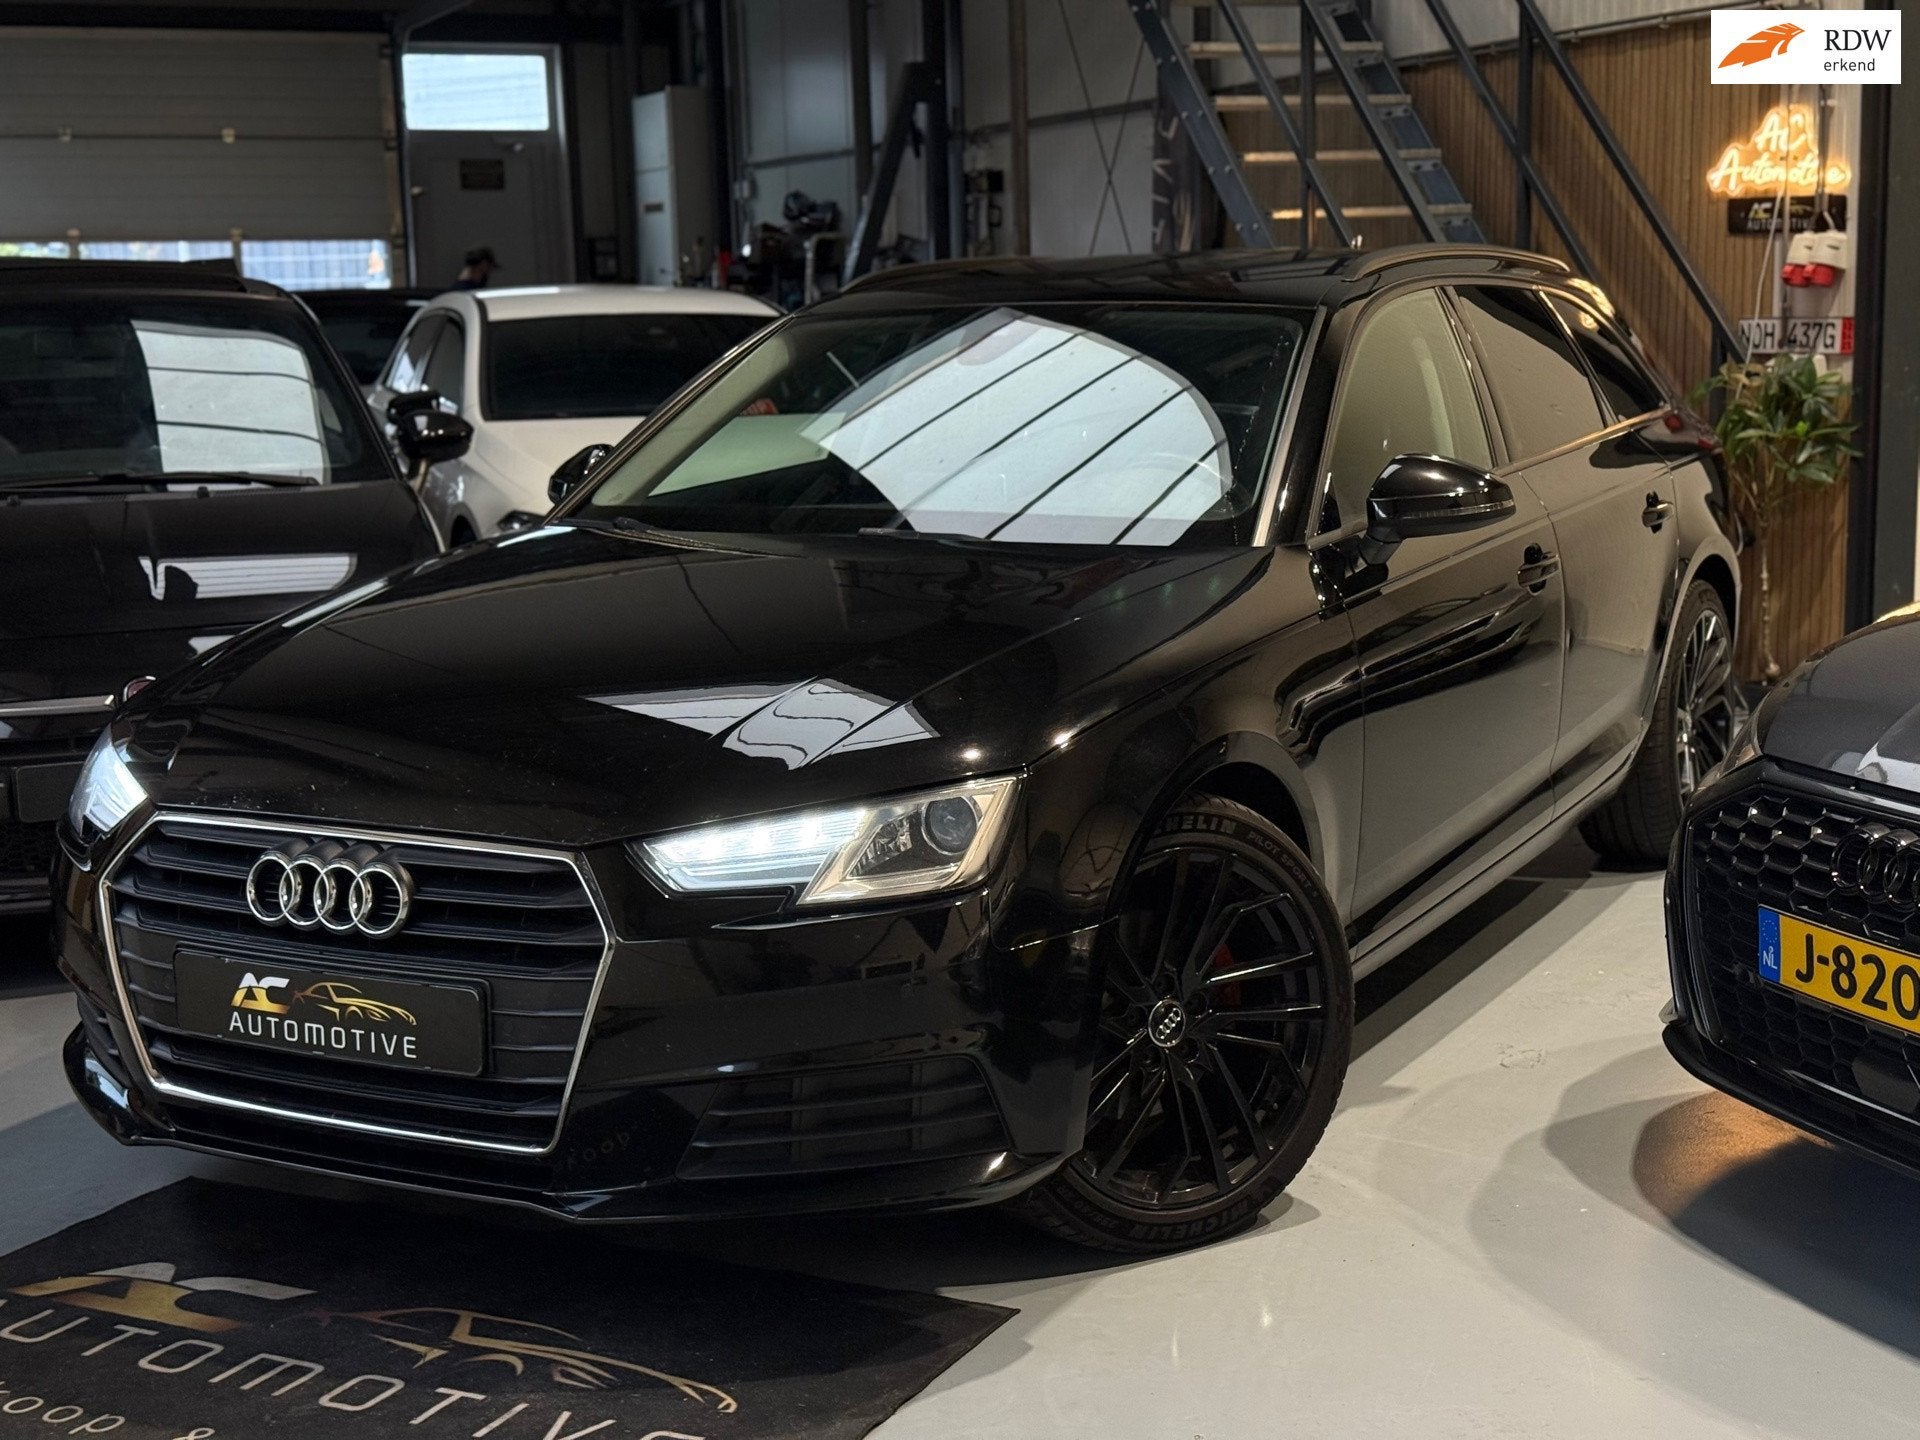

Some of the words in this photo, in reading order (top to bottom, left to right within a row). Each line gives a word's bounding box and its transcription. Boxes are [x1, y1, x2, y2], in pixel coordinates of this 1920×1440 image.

[1710, 147, 1848, 189] Automotie
[1762, 952, 1778, 970] NL
[230, 972, 290, 1015] AC
[229, 1011, 418, 1059] AUTOMOTIVE
[0, 1302, 706, 1440] UTOMOTIV
[0, 1381, 126, 1435] oop
